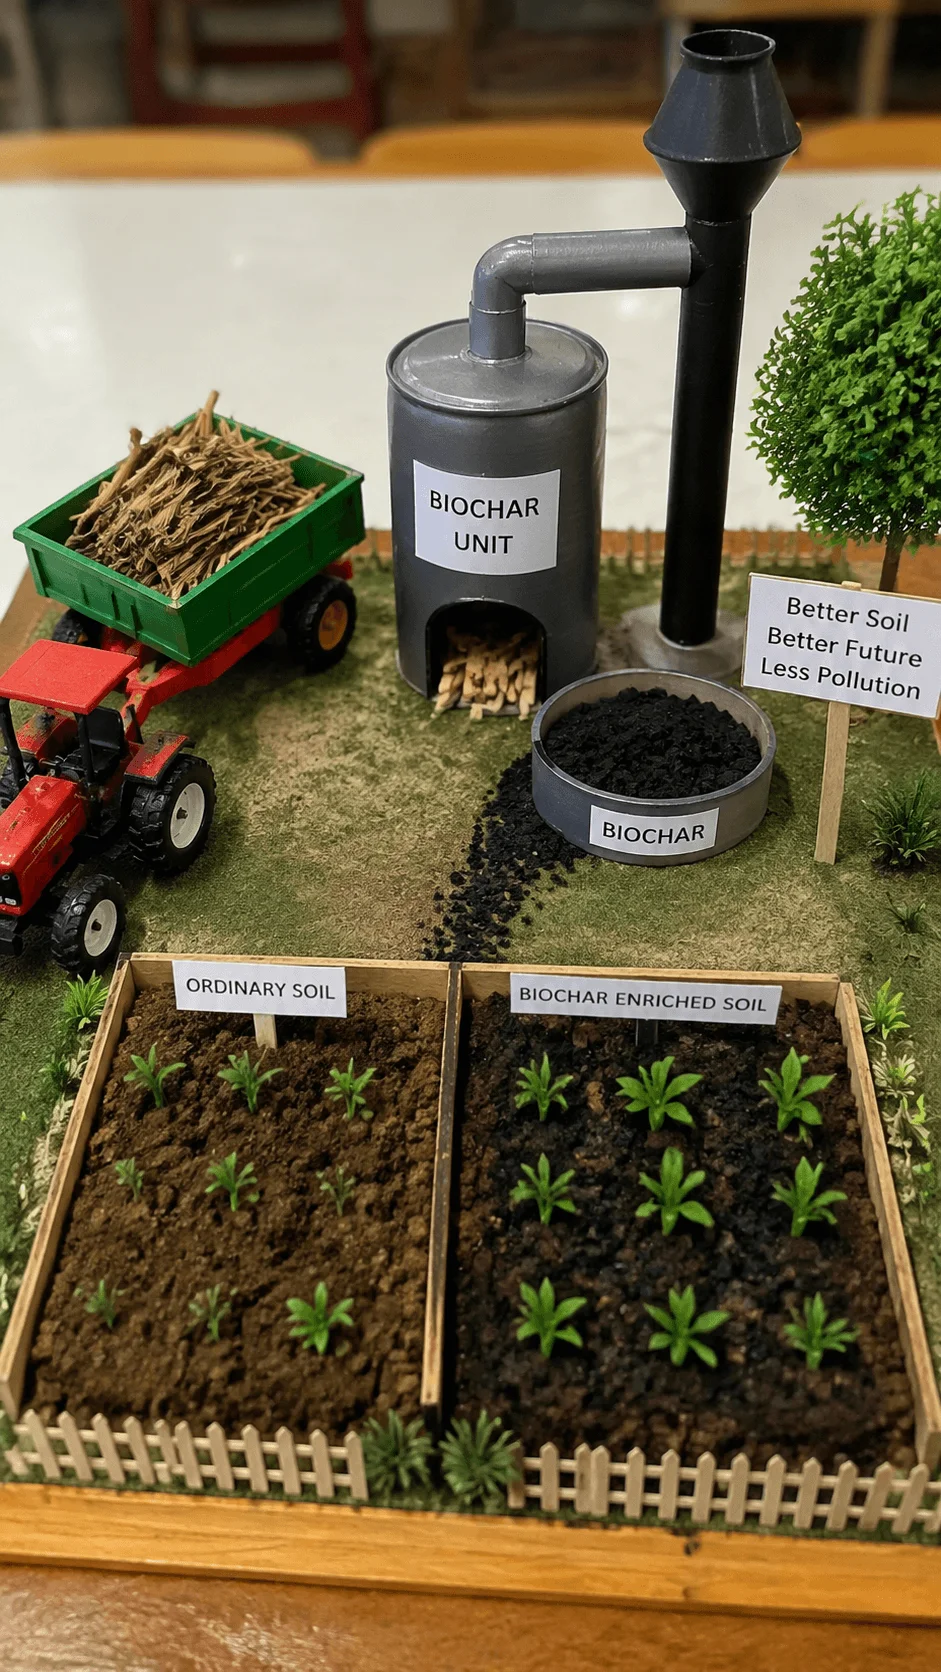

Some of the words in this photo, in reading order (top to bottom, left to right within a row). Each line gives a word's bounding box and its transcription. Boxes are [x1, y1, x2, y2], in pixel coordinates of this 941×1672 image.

[430, 490, 539, 519] BIOCHAR
[454, 531, 513, 554] UNIT
[787, 596, 859, 624] Better
[866, 609, 909, 632] Soil
[767, 626, 839, 654] Better
[845, 639, 922, 667] Future
[761, 657, 810, 681] Less
[817, 666, 921, 700] Pollution
[603, 821, 705, 844] BIOCHAR
[186, 978, 286, 997] ORDINARY
[292, 983, 335, 1000] SOIL
[519, 987, 608, 1004] BIOCHAR
[615, 992, 716, 1010] ENRICHED
[723, 997, 767, 1012] SOIL
